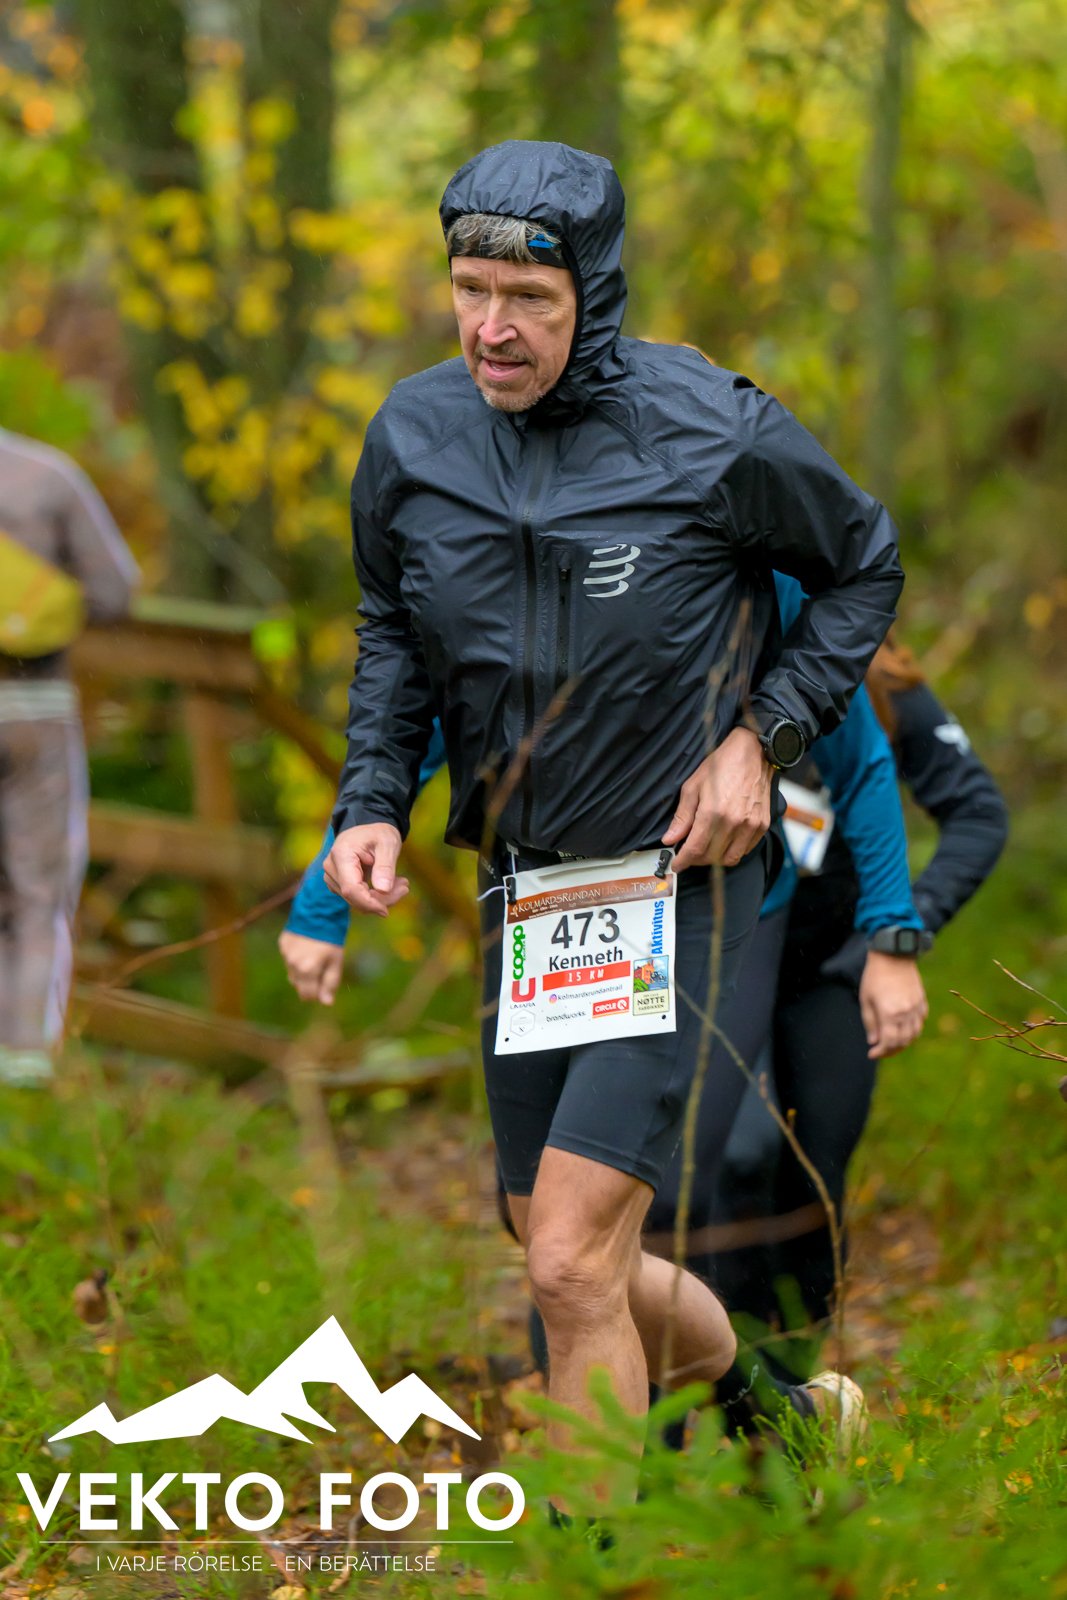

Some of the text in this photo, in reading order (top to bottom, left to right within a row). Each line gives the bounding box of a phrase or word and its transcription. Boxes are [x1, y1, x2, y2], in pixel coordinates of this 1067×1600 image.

[551, 908, 620, 950] 473
[651, 900, 665, 955] Aktivitus
[512, 924, 526, 980] coop
[549, 946, 623, 972] Kenneth
[568, 968, 605, 983] 15 KM
[594, 1002, 617, 1013] CIRCLE
